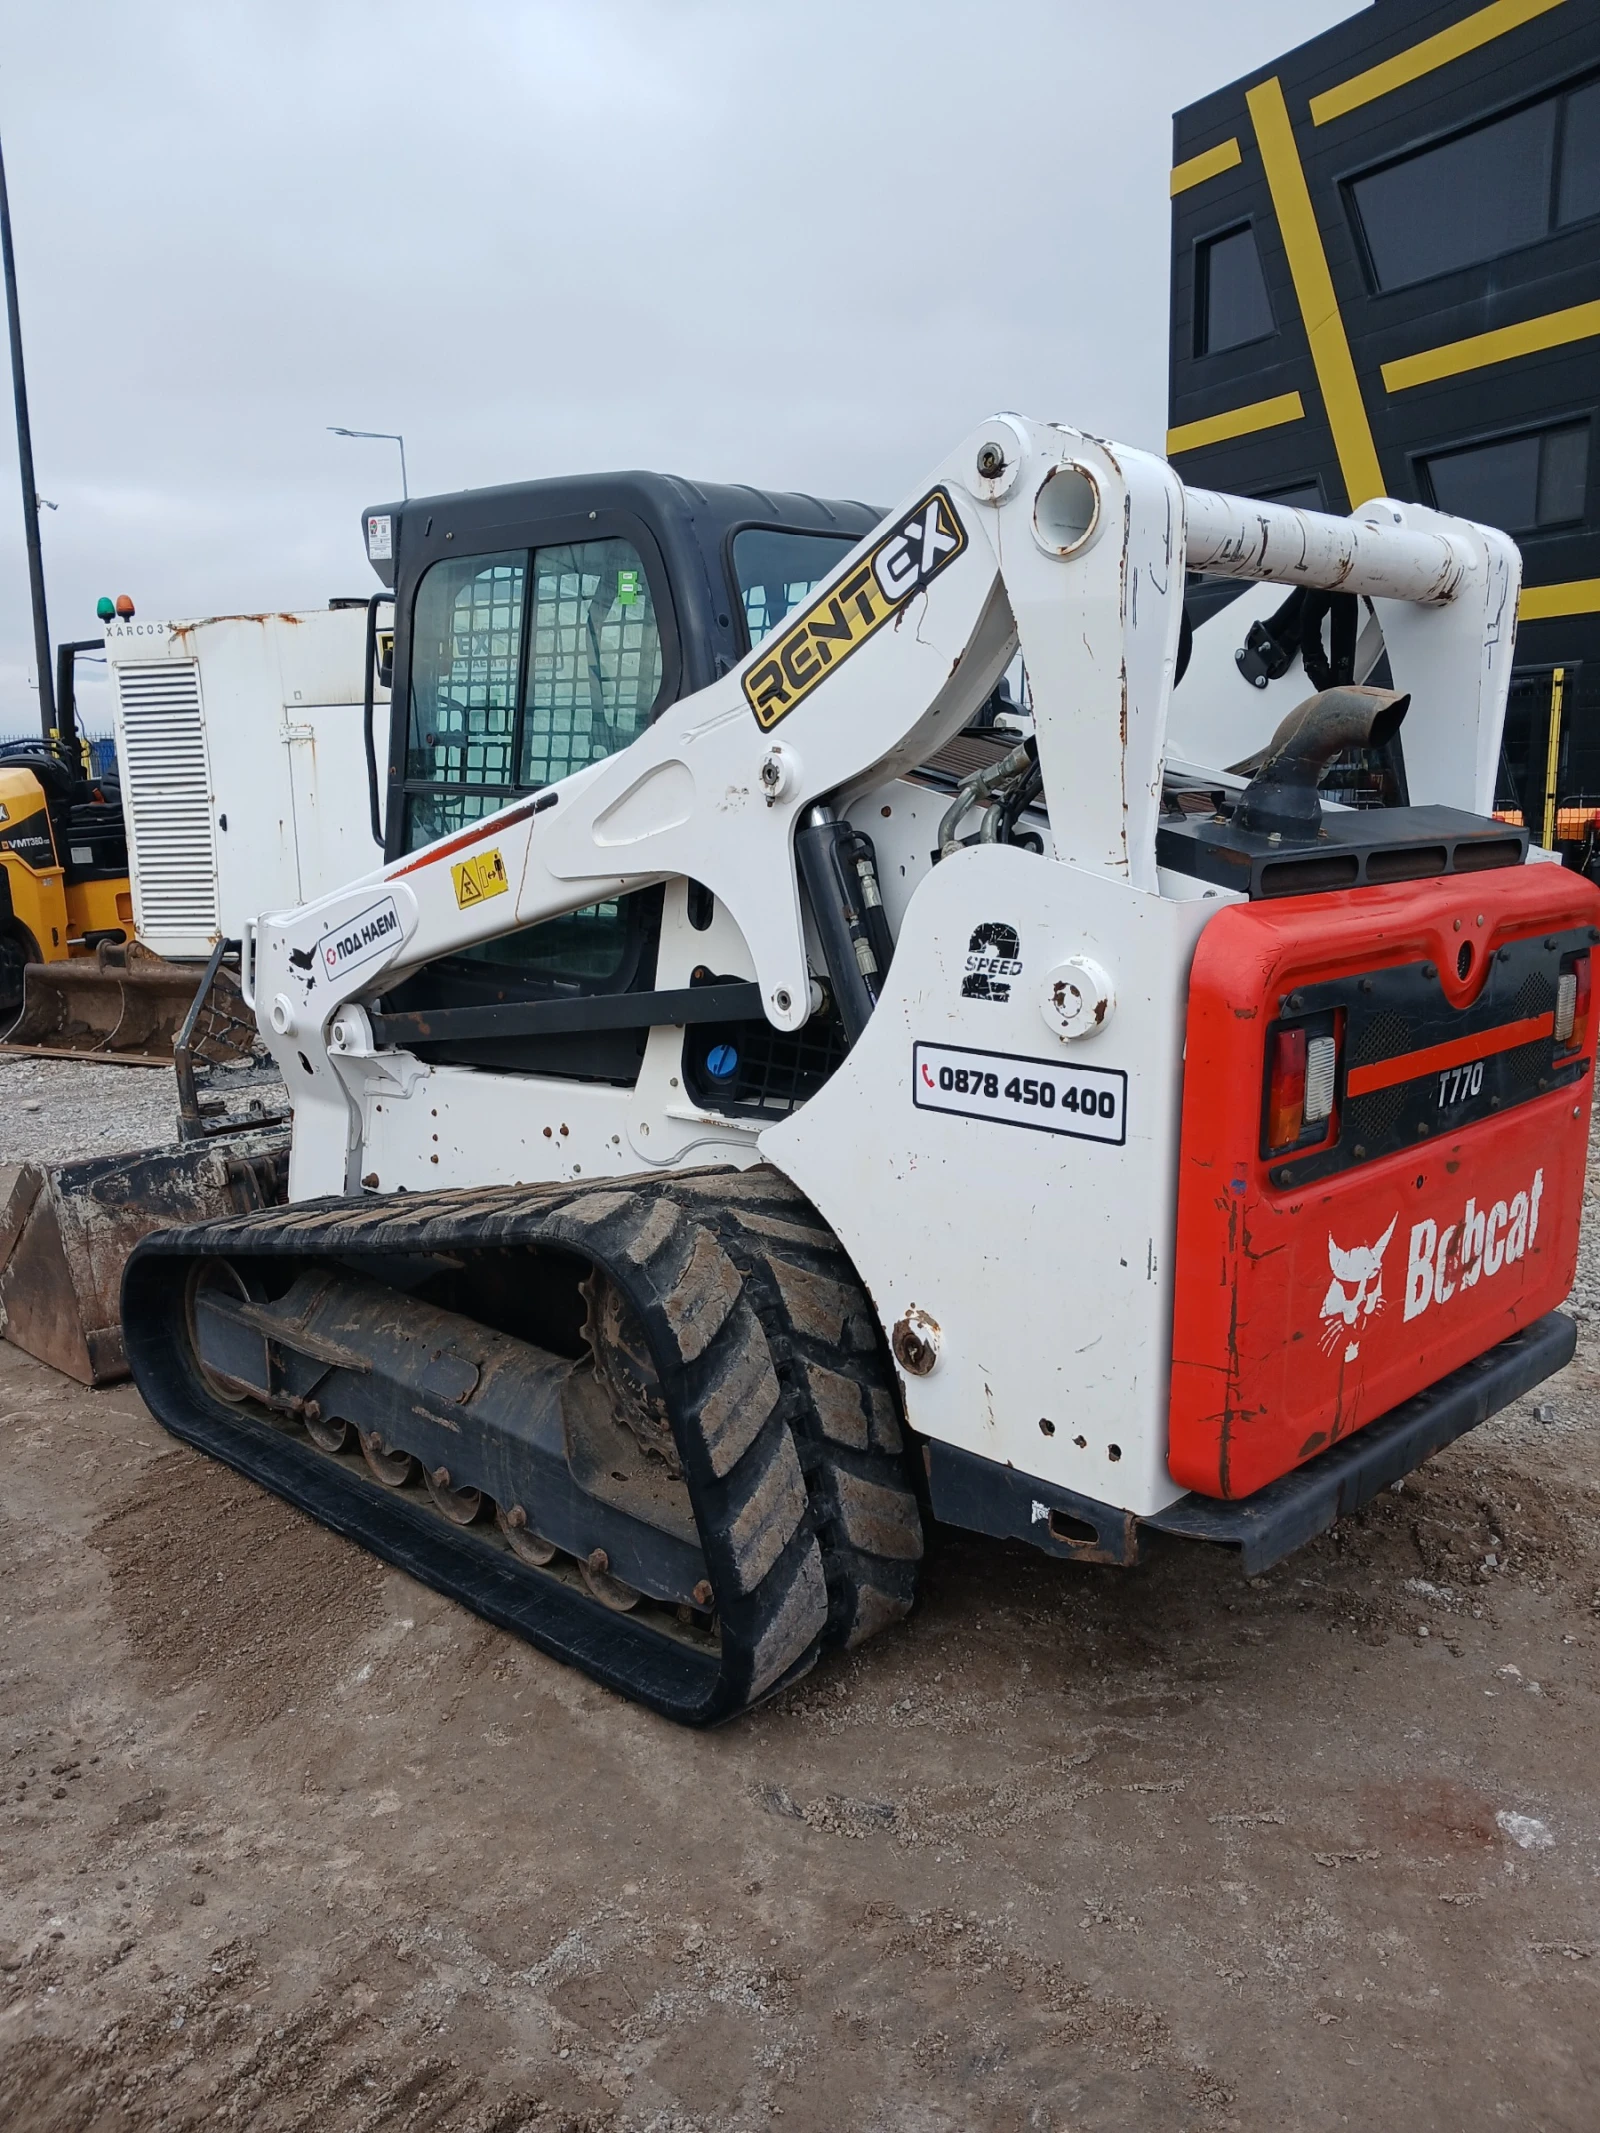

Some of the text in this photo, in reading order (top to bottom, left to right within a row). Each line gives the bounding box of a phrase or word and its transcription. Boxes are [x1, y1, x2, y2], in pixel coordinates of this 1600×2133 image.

[750, 501, 957, 722] RENTEX
[336, 910, 397, 960] ПОД НАЕМ
[964, 955, 1023, 977] SPEED
[939, 1066, 1115, 1119] 0878 450 400
[1438, 1061, 1485, 1108] T770
[1403, 1168, 1545, 1323] Bobcat
